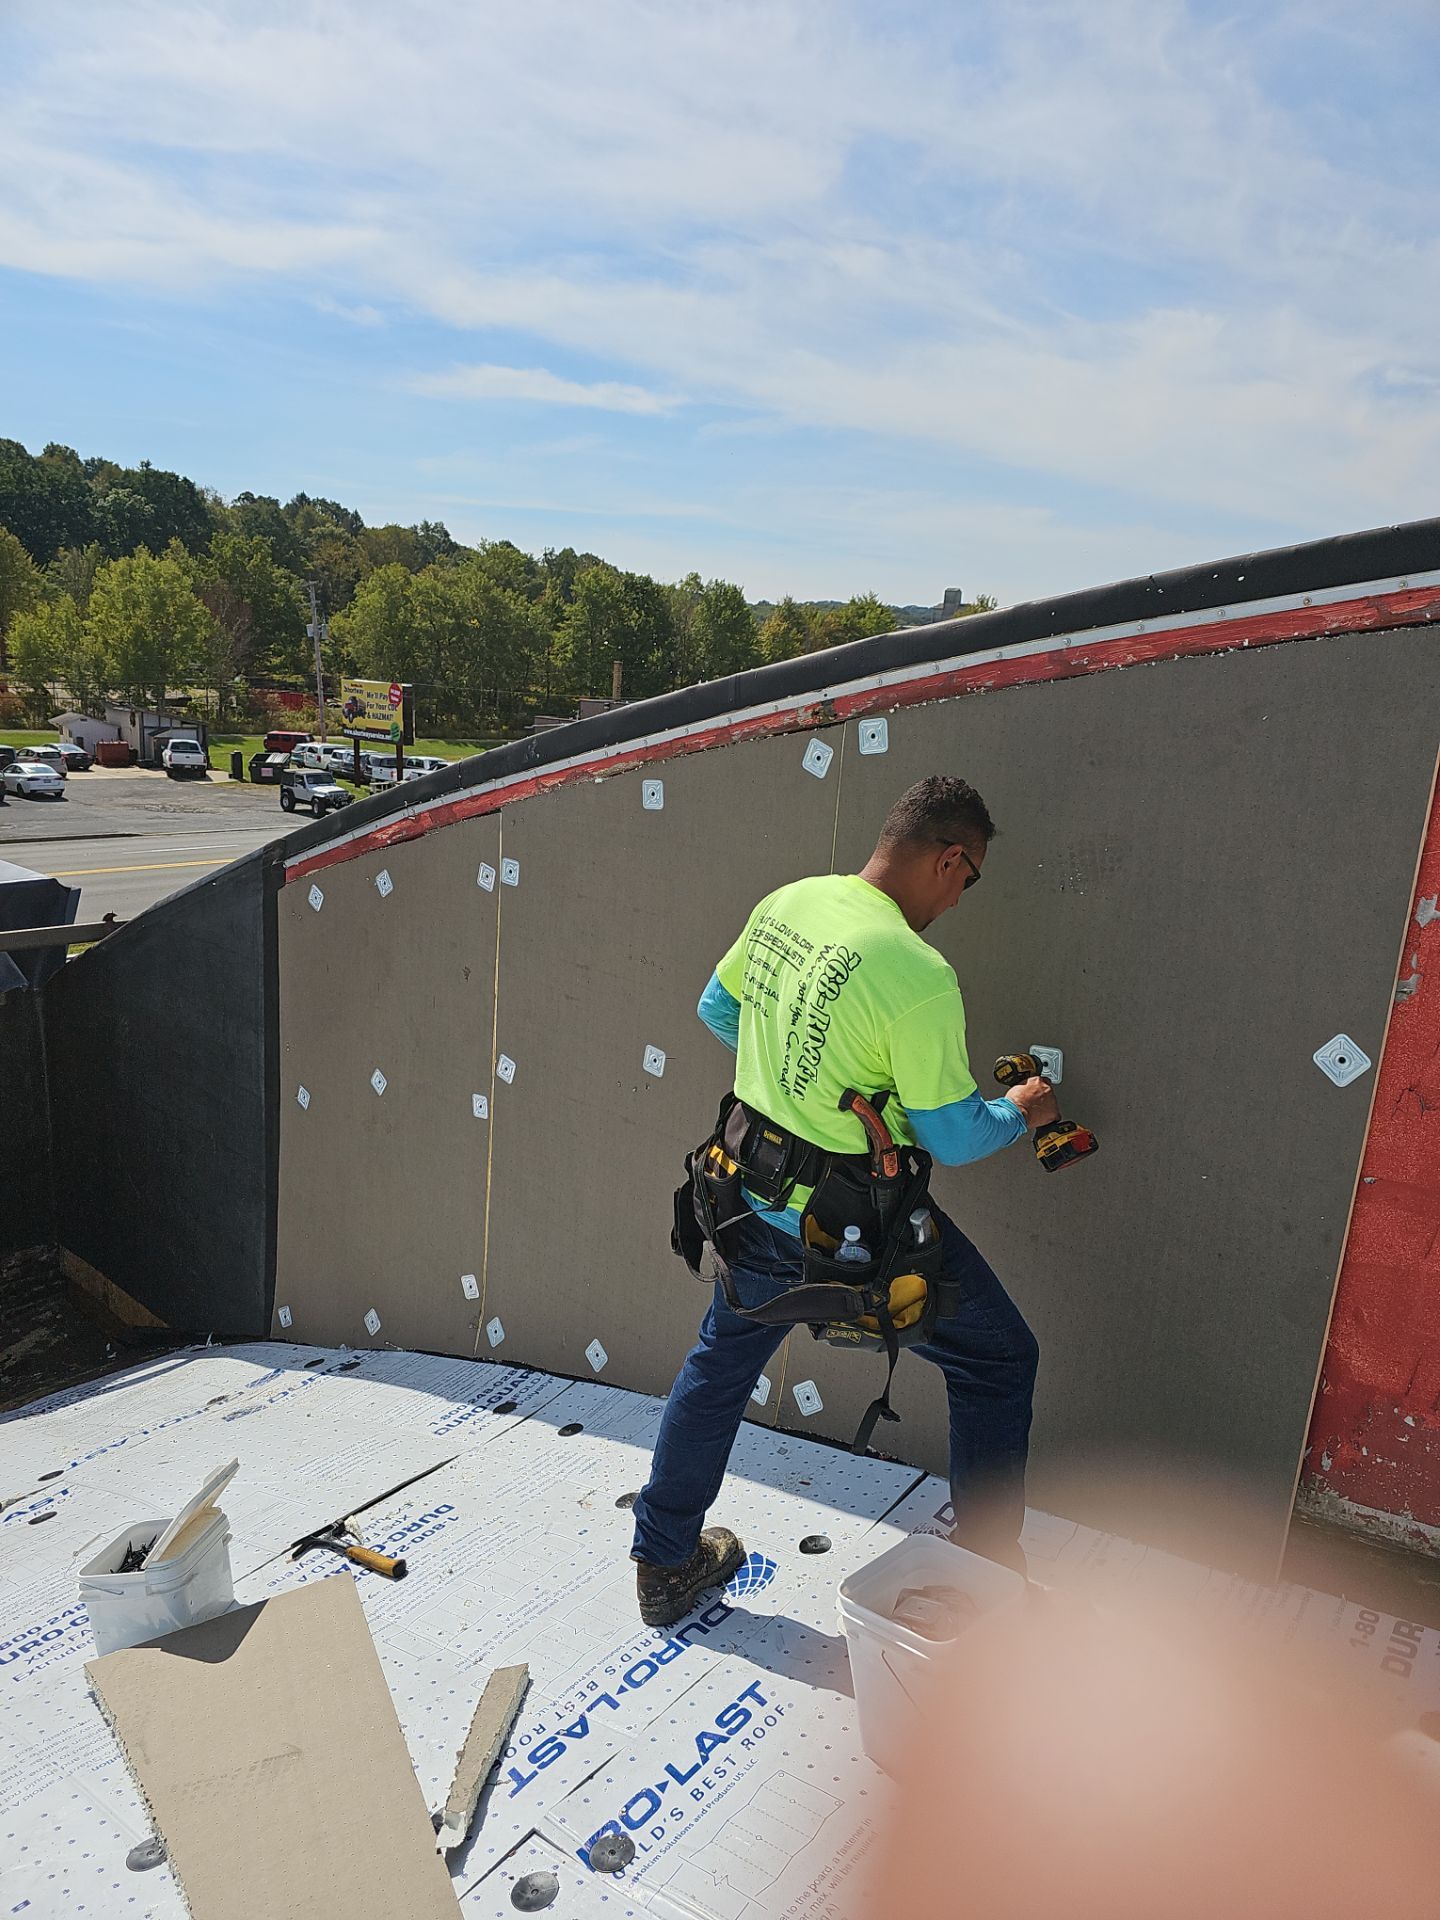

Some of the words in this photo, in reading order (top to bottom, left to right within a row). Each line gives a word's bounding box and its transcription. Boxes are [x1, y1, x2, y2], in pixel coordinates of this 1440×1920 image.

[375, 703, 387, 711] Your
[379, 693, 389, 701] Pay
[763, 932, 806, 967] SPECIALISTS
[774, 921, 794, 937] LOW
[791, 932, 815, 954] SLOPE
[797, 979, 807, 1005] got
[789, 1002, 803, 1026] you
[24, 1641, 65, 1665] XPS
[622, 1600, 736, 1690] DURO
[1380, 1620, 1425, 1679] DUR
[553, 1679, 599, 1722] BEST
[507, 1691, 620, 1799] LAST
[663, 1679, 768, 1786] LAST
[690, 1753, 737, 1802] BEST
[740, 1703, 788, 1752] ROOF
[659, 1821, 695, 1856] Solutions
[693, 1806, 709, 1824] and
[706, 1780, 736, 1811] Products
[744, 1758, 760, 1774] LLC.
[786, 1905, 798, 1917] to
[794, 1888, 811, 1906] the
[808, 1864, 835, 1893] board,
[809, 1890, 832, 1913] max,
[828, 1874, 842, 1891] will
